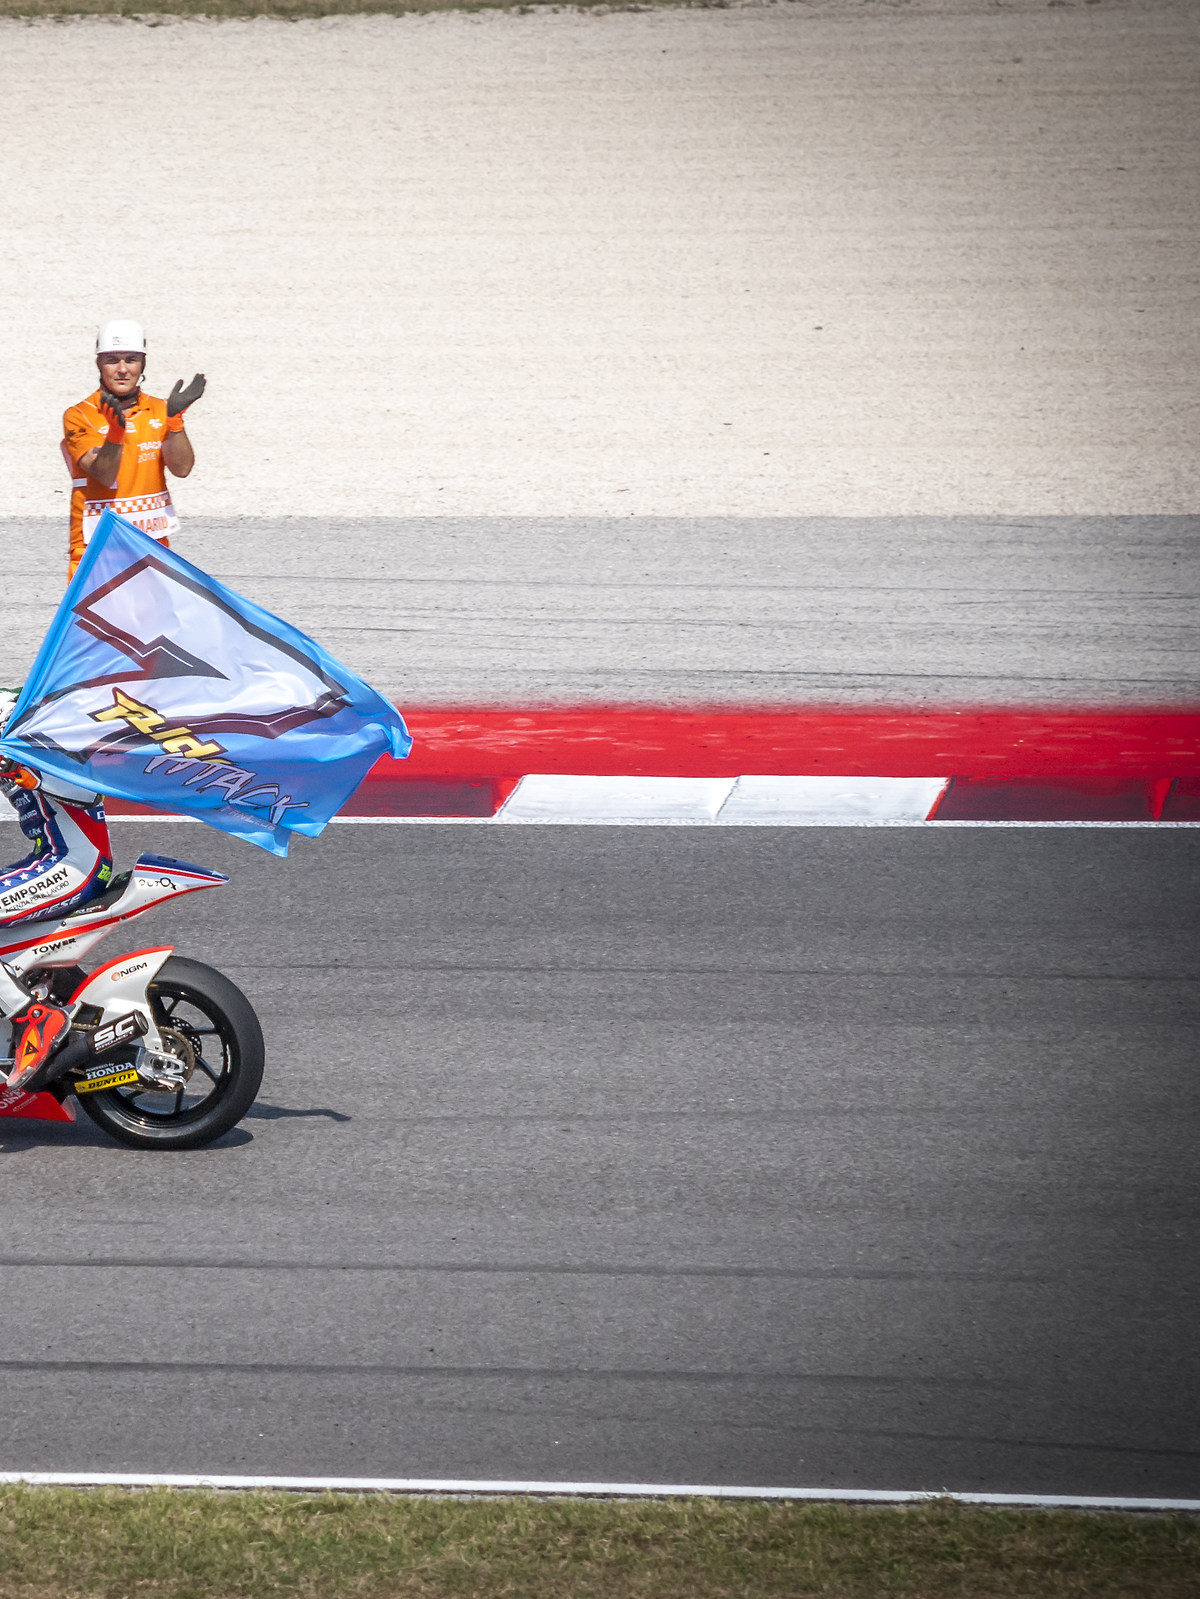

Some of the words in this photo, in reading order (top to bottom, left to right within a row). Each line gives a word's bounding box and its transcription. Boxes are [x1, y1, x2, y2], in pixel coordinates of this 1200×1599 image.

[32, 937, 76, 955] TOWER
[120, 962, 148, 977] NGM
[94, 1015, 134, 1048] SC
[86, 1061, 136, 1080] HONDA
[88, 1072, 135, 1089] DUNLOP
